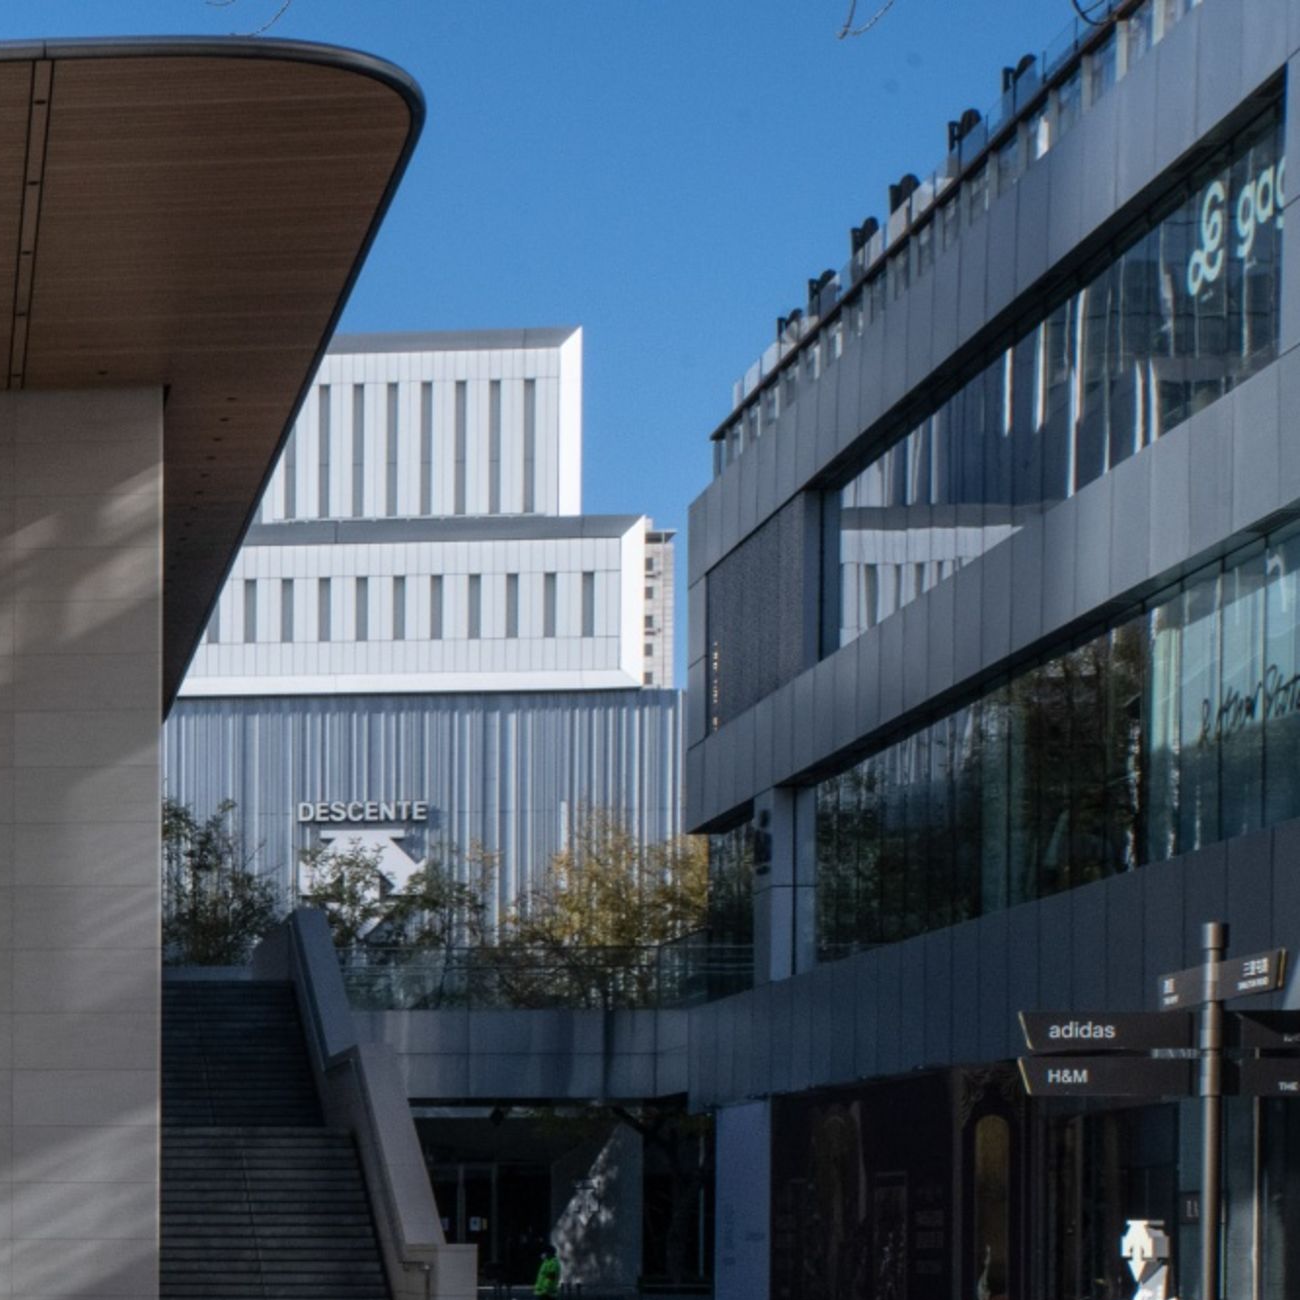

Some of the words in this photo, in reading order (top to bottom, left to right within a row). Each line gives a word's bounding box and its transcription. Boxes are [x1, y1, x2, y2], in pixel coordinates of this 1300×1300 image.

[297, 800, 429, 822] DESCENTE
[1049, 1021, 1116, 1039] adidas
[1047, 1069, 1088, 1084] H&M
